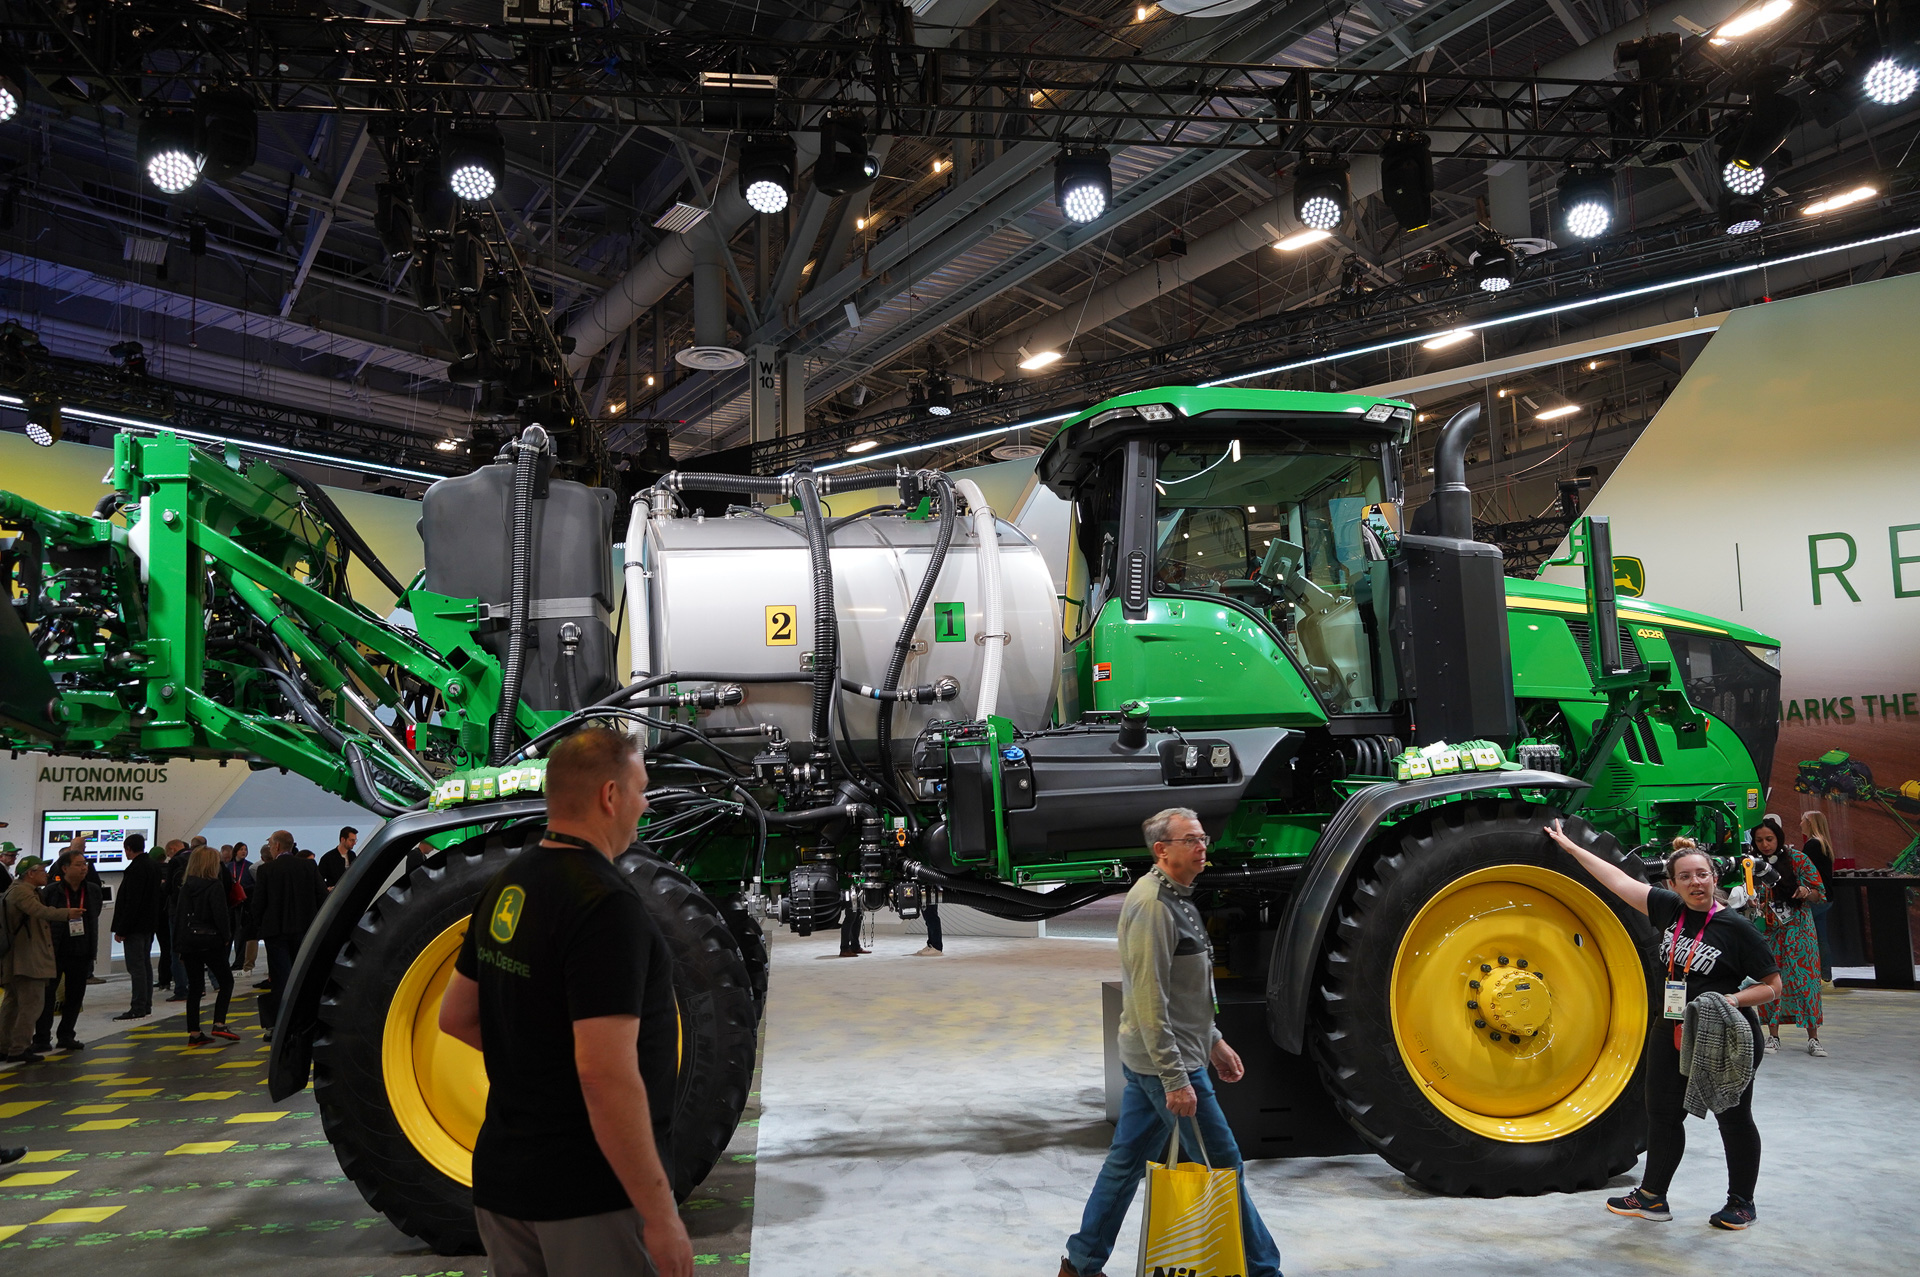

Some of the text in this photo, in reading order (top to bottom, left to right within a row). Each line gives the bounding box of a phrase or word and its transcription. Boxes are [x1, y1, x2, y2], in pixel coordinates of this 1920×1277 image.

[760, 361, 773, 374] W
[759, 376, 774, 389] 10
[1808, 523, 1920, 605] RE
[771, 612, 792, 640] 2
[941, 609, 959, 637] 1
[1861, 693, 1919, 717] THE
[39, 767, 168, 783] AUTONOMOUS
[63, 786, 144, 802] FARMING
[496, 950, 531, 978] DEERE
